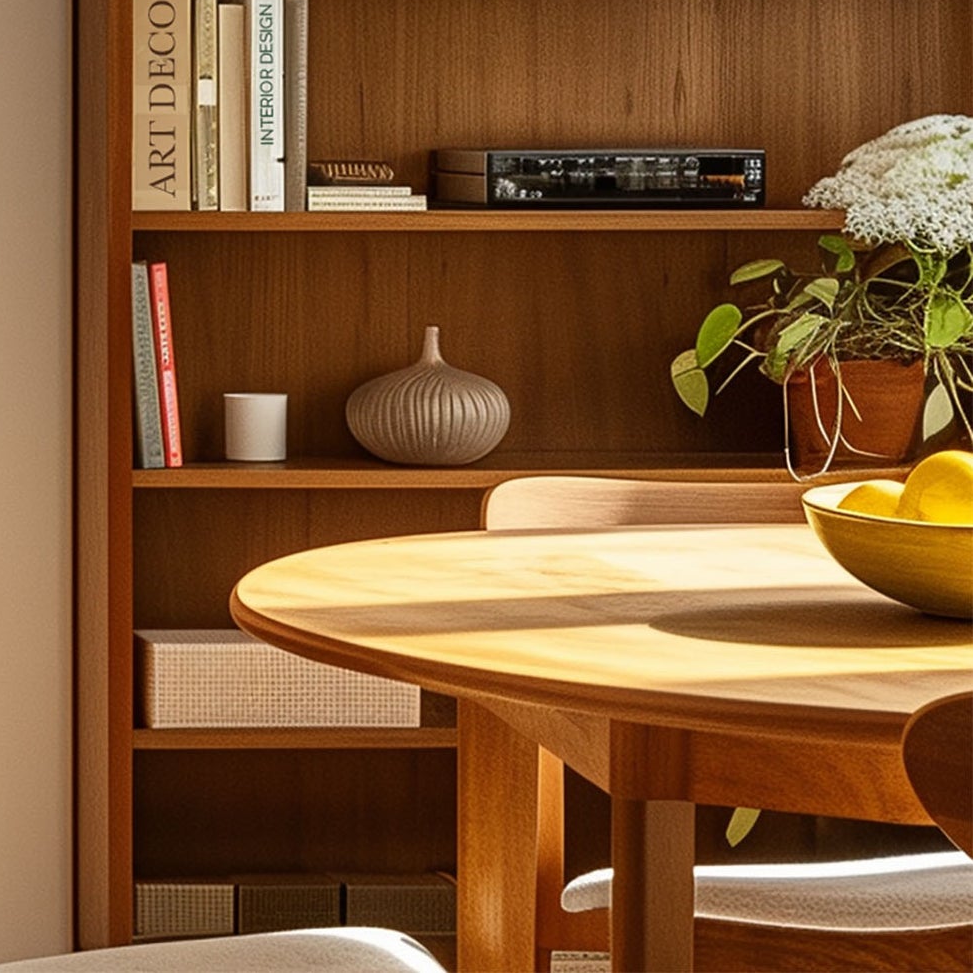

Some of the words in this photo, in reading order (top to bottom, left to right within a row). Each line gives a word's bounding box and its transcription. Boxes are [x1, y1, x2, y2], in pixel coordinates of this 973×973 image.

[146, 0, 177, 112] DECO
[258, 3, 275, 65] DESIGN
[258, 68, 275, 146] INTERIOR
[147, 119, 177, 198] ART
